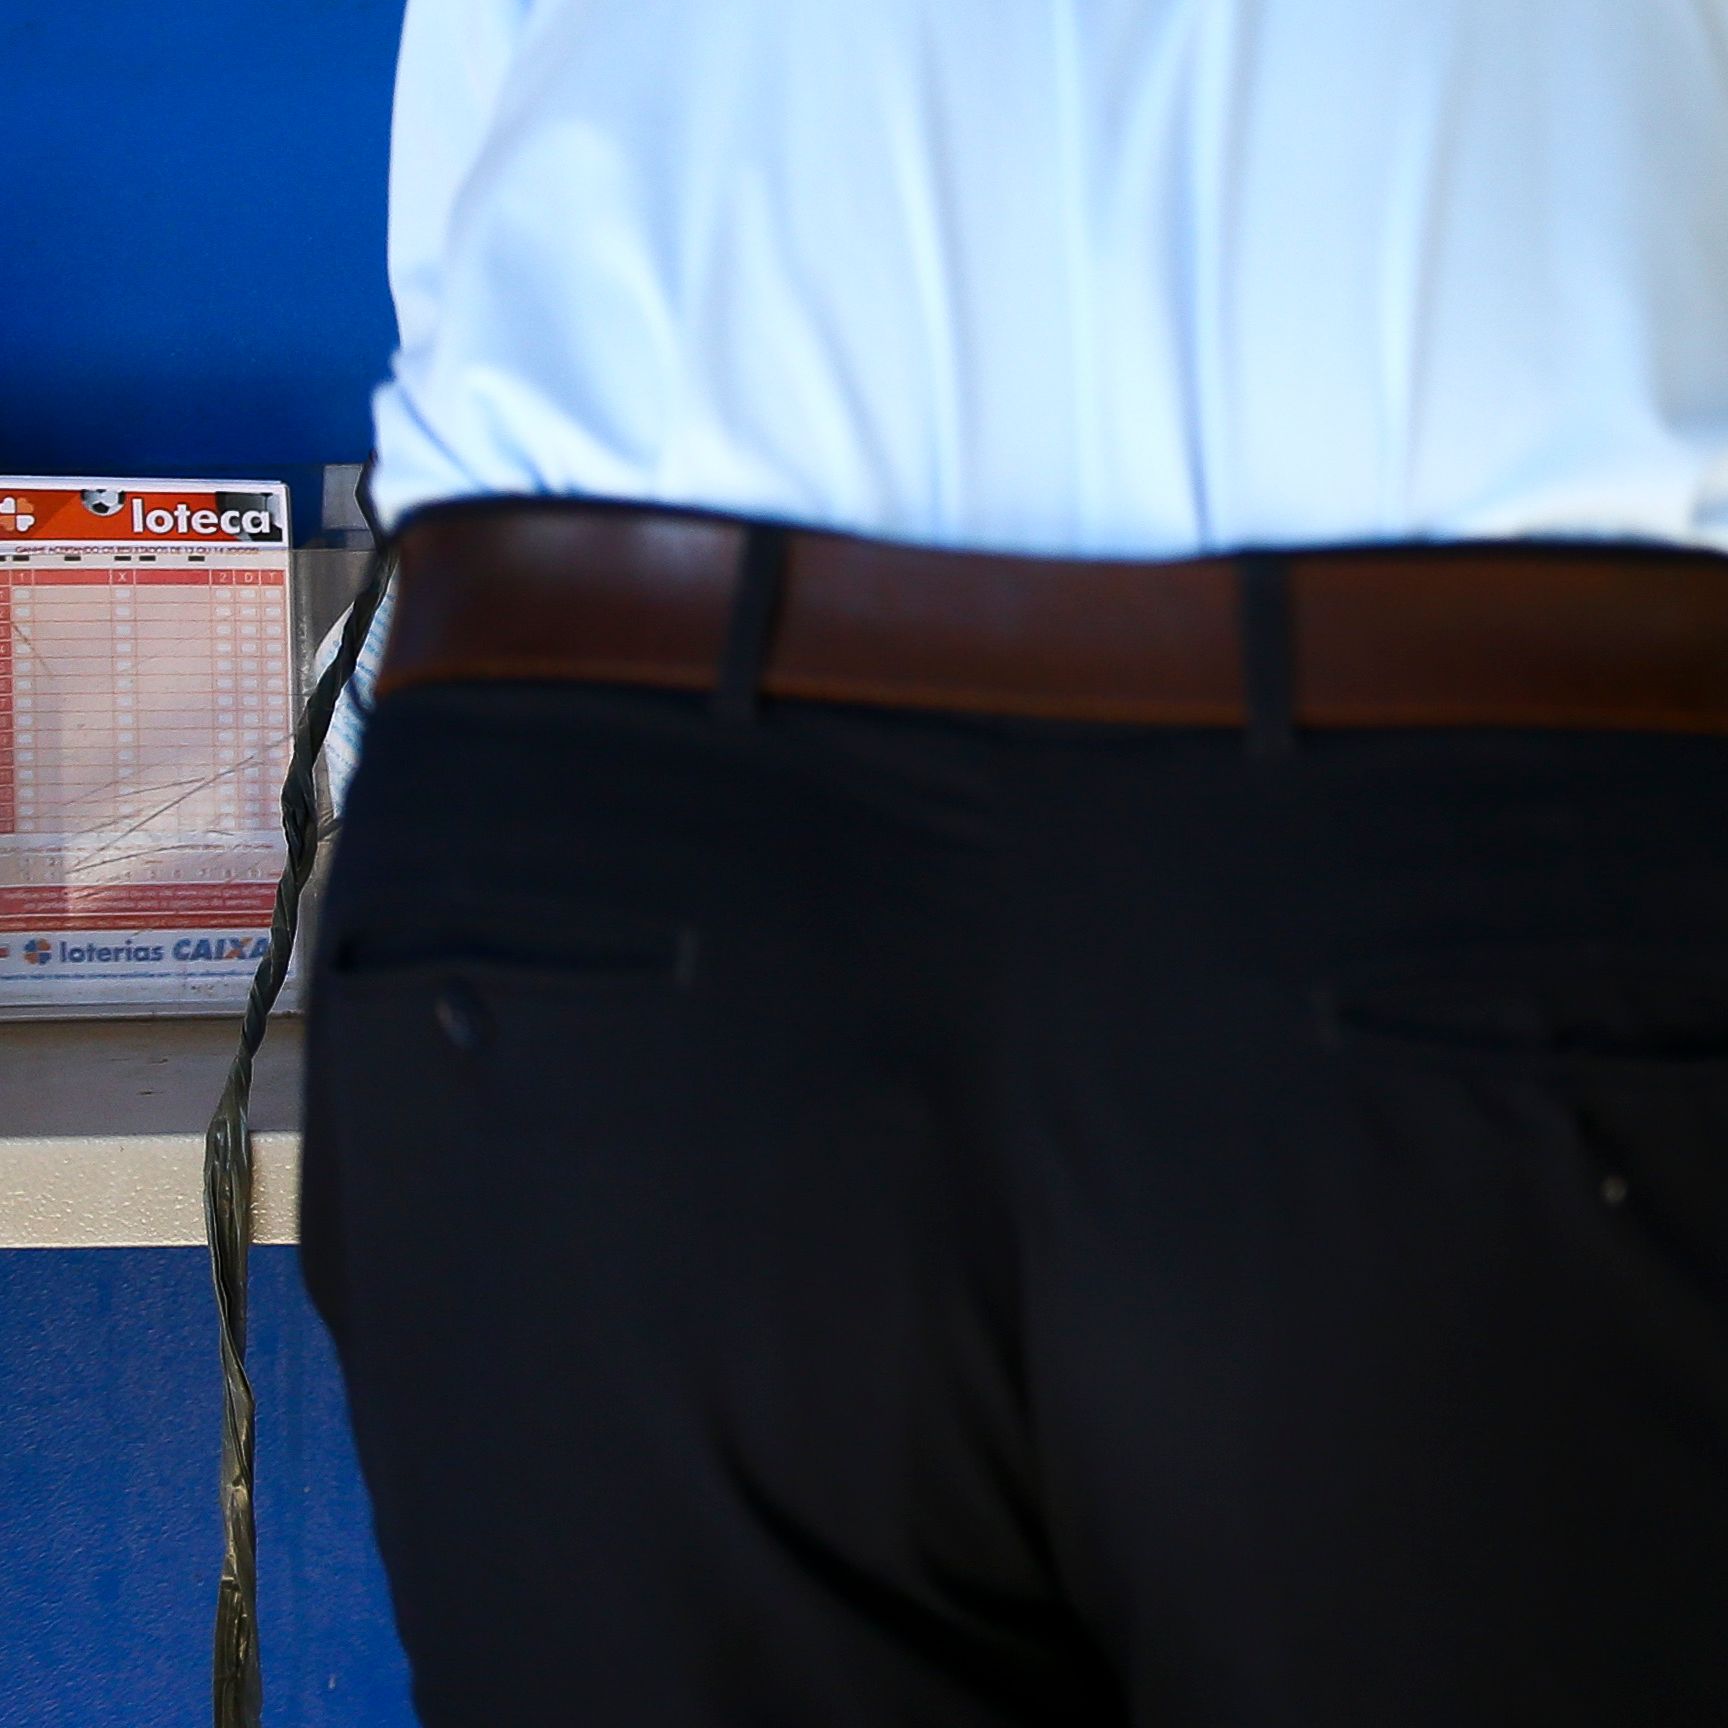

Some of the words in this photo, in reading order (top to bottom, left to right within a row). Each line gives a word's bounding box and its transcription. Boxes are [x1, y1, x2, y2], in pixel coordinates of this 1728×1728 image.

[132, 498, 270, 534] loteca
[118, 573, 127, 582] X
[219, 573, 227, 581] 2
[244, 573, 253, 582] D
[59, 939, 163, 963] loterias
[173, 937, 271, 960] CAIXA
